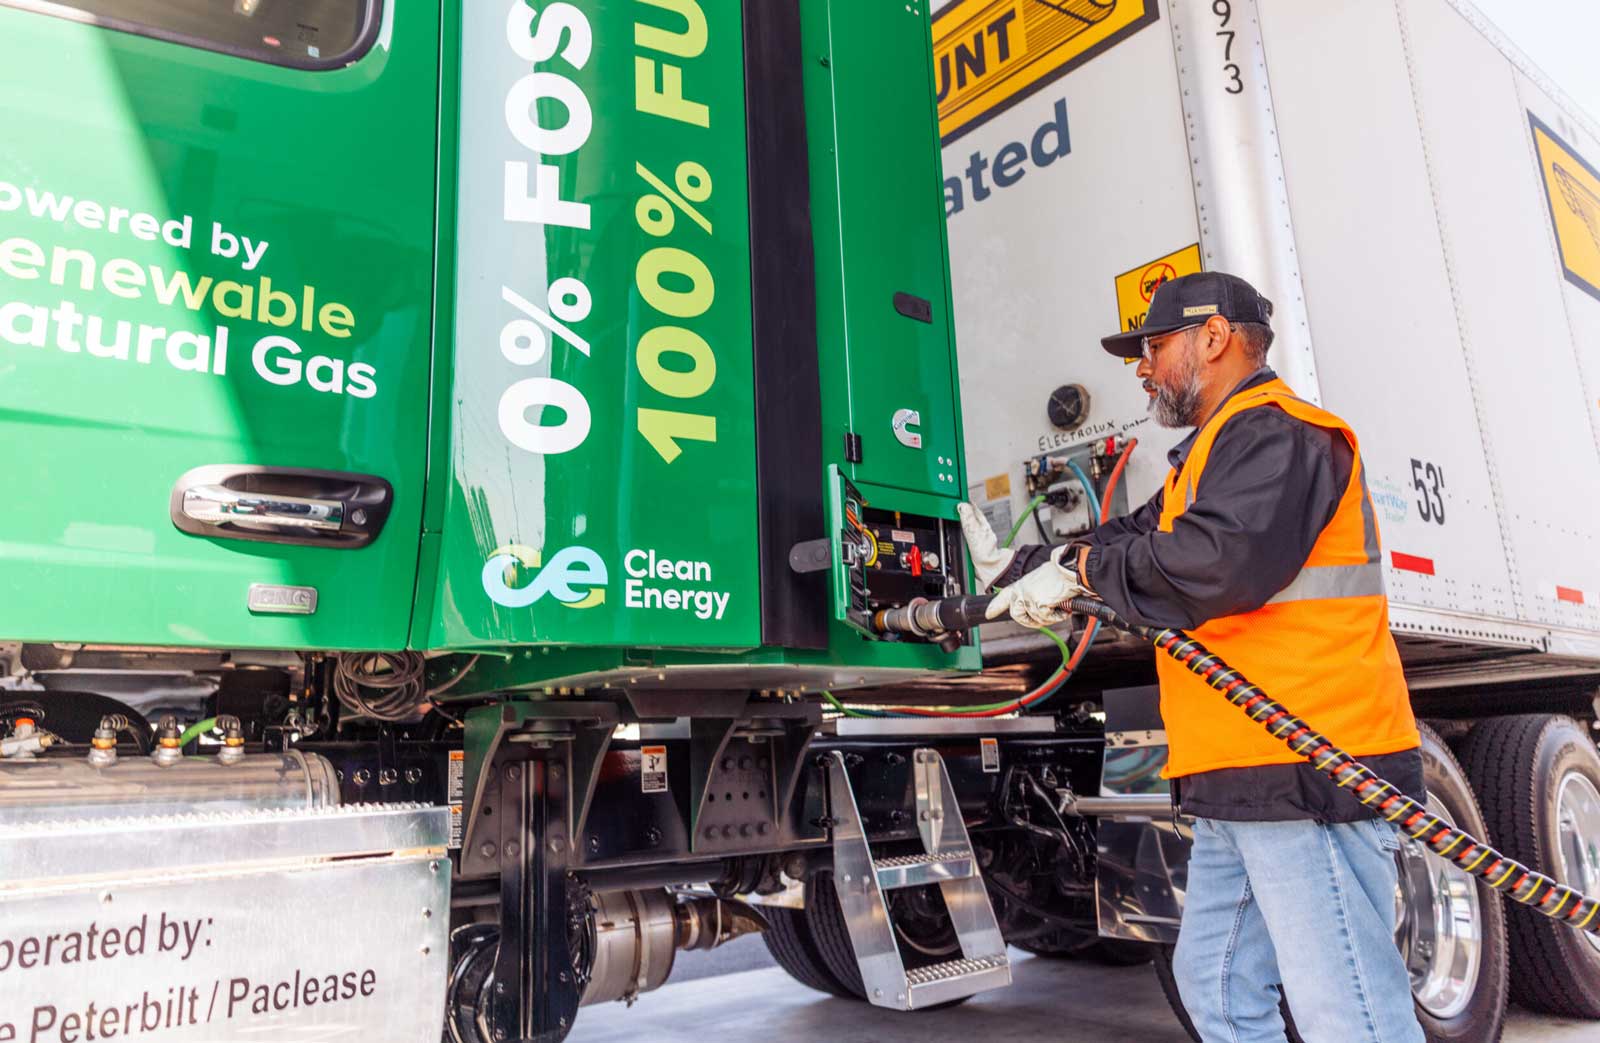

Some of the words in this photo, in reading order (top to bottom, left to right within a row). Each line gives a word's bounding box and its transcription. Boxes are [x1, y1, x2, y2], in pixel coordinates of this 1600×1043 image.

[634, 0, 710, 129] FU
[504, 0, 592, 230] FOS
[943, 97, 1071, 218] ated
[0, 181, 193, 249] owered
[211, 222, 269, 270] by
[0, 238, 355, 338] enewable
[635, 161, 717, 464] 100%
[0, 301, 229, 376] atural
[252, 335, 377, 399] Gas
[498, 277, 592, 455] 0%
[1038, 419, 1116, 451] ELECTROLUX
[624, 548, 711, 581] Clean
[624, 579, 730, 620] Energy
[158, 911, 215, 960] by:
[30, 986, 199, 1043] Peterbilt
[227, 968, 377, 1019] Paclease
